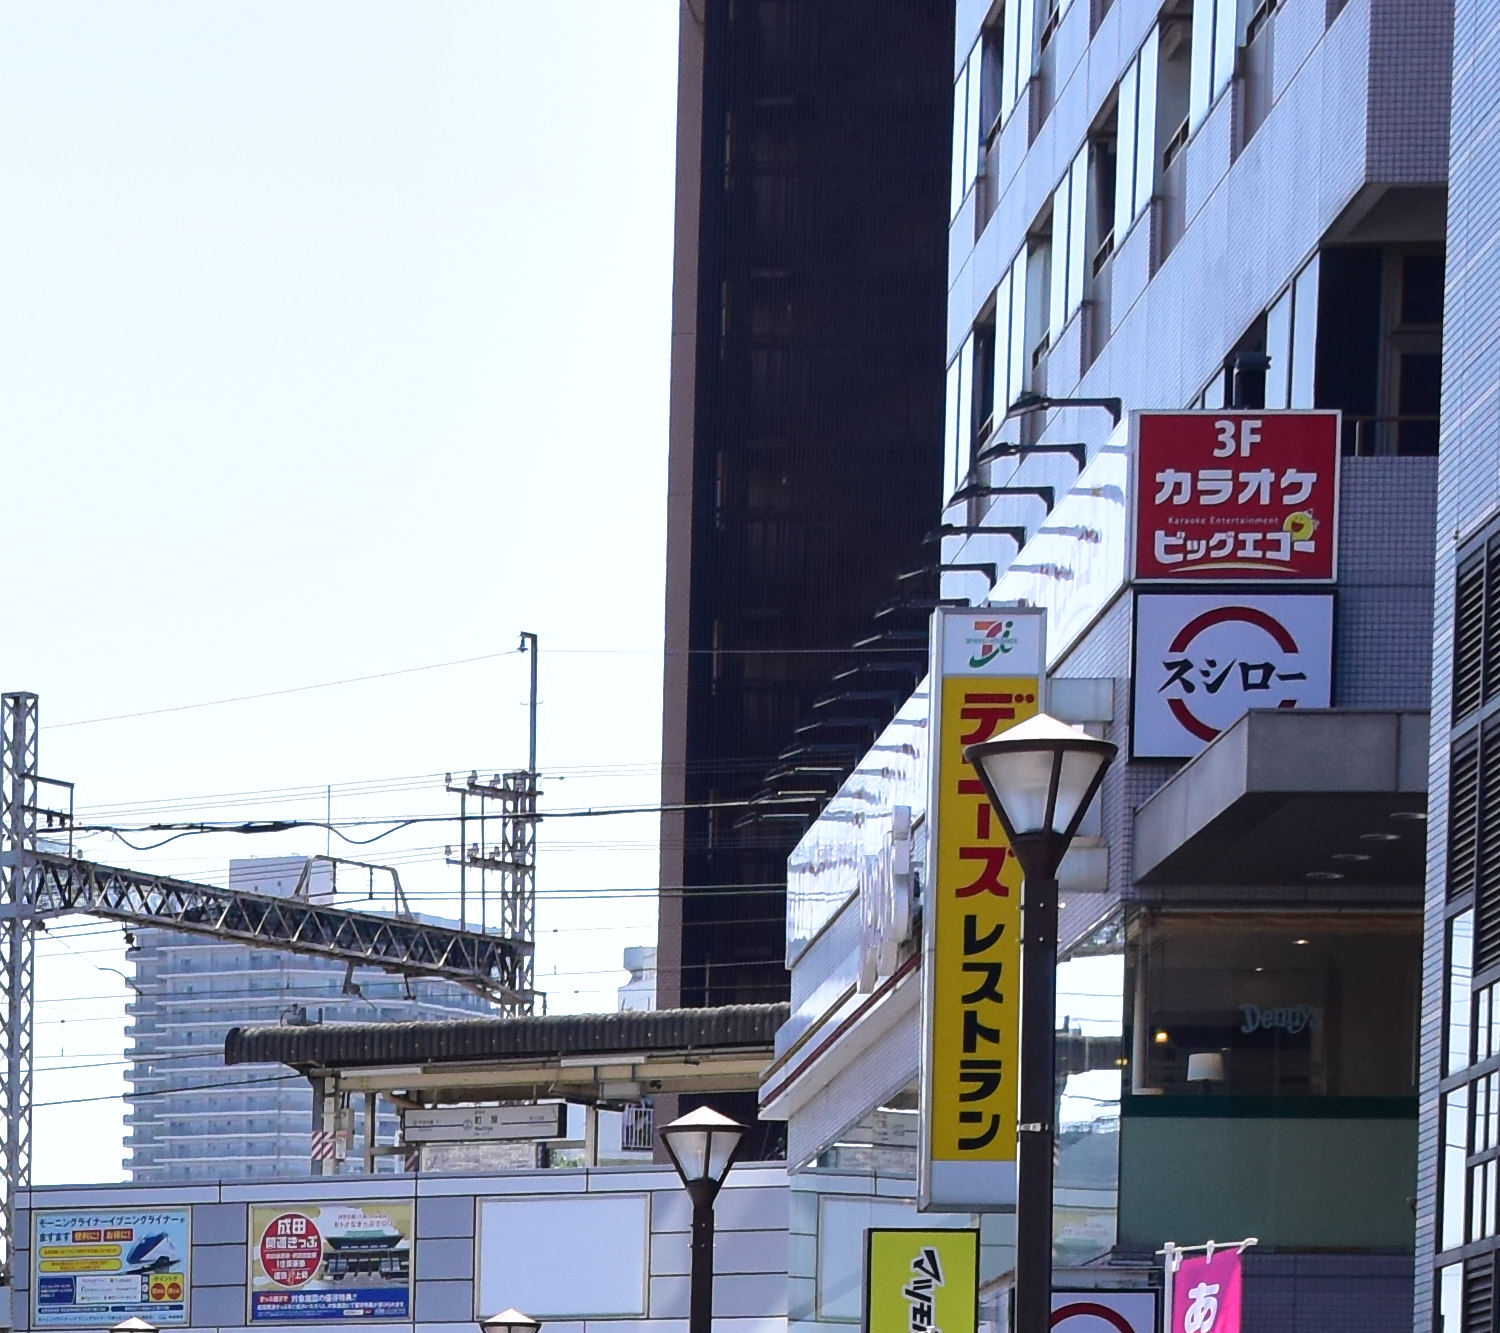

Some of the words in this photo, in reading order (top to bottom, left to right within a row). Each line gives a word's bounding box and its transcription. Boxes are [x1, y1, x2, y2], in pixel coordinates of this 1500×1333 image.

[1214, 420, 1263, 458] 3F
[1155, 469, 1317, 506] カラオケ
[1168, 516, 1206, 525] Karaoke
[1210, 516, 1279, 525] Entertainment
[1154, 529, 1316, 564] ビッグエコー
[1158, 658, 1308, 694] スシロー
[277, 1218, 306, 1235] 成田
